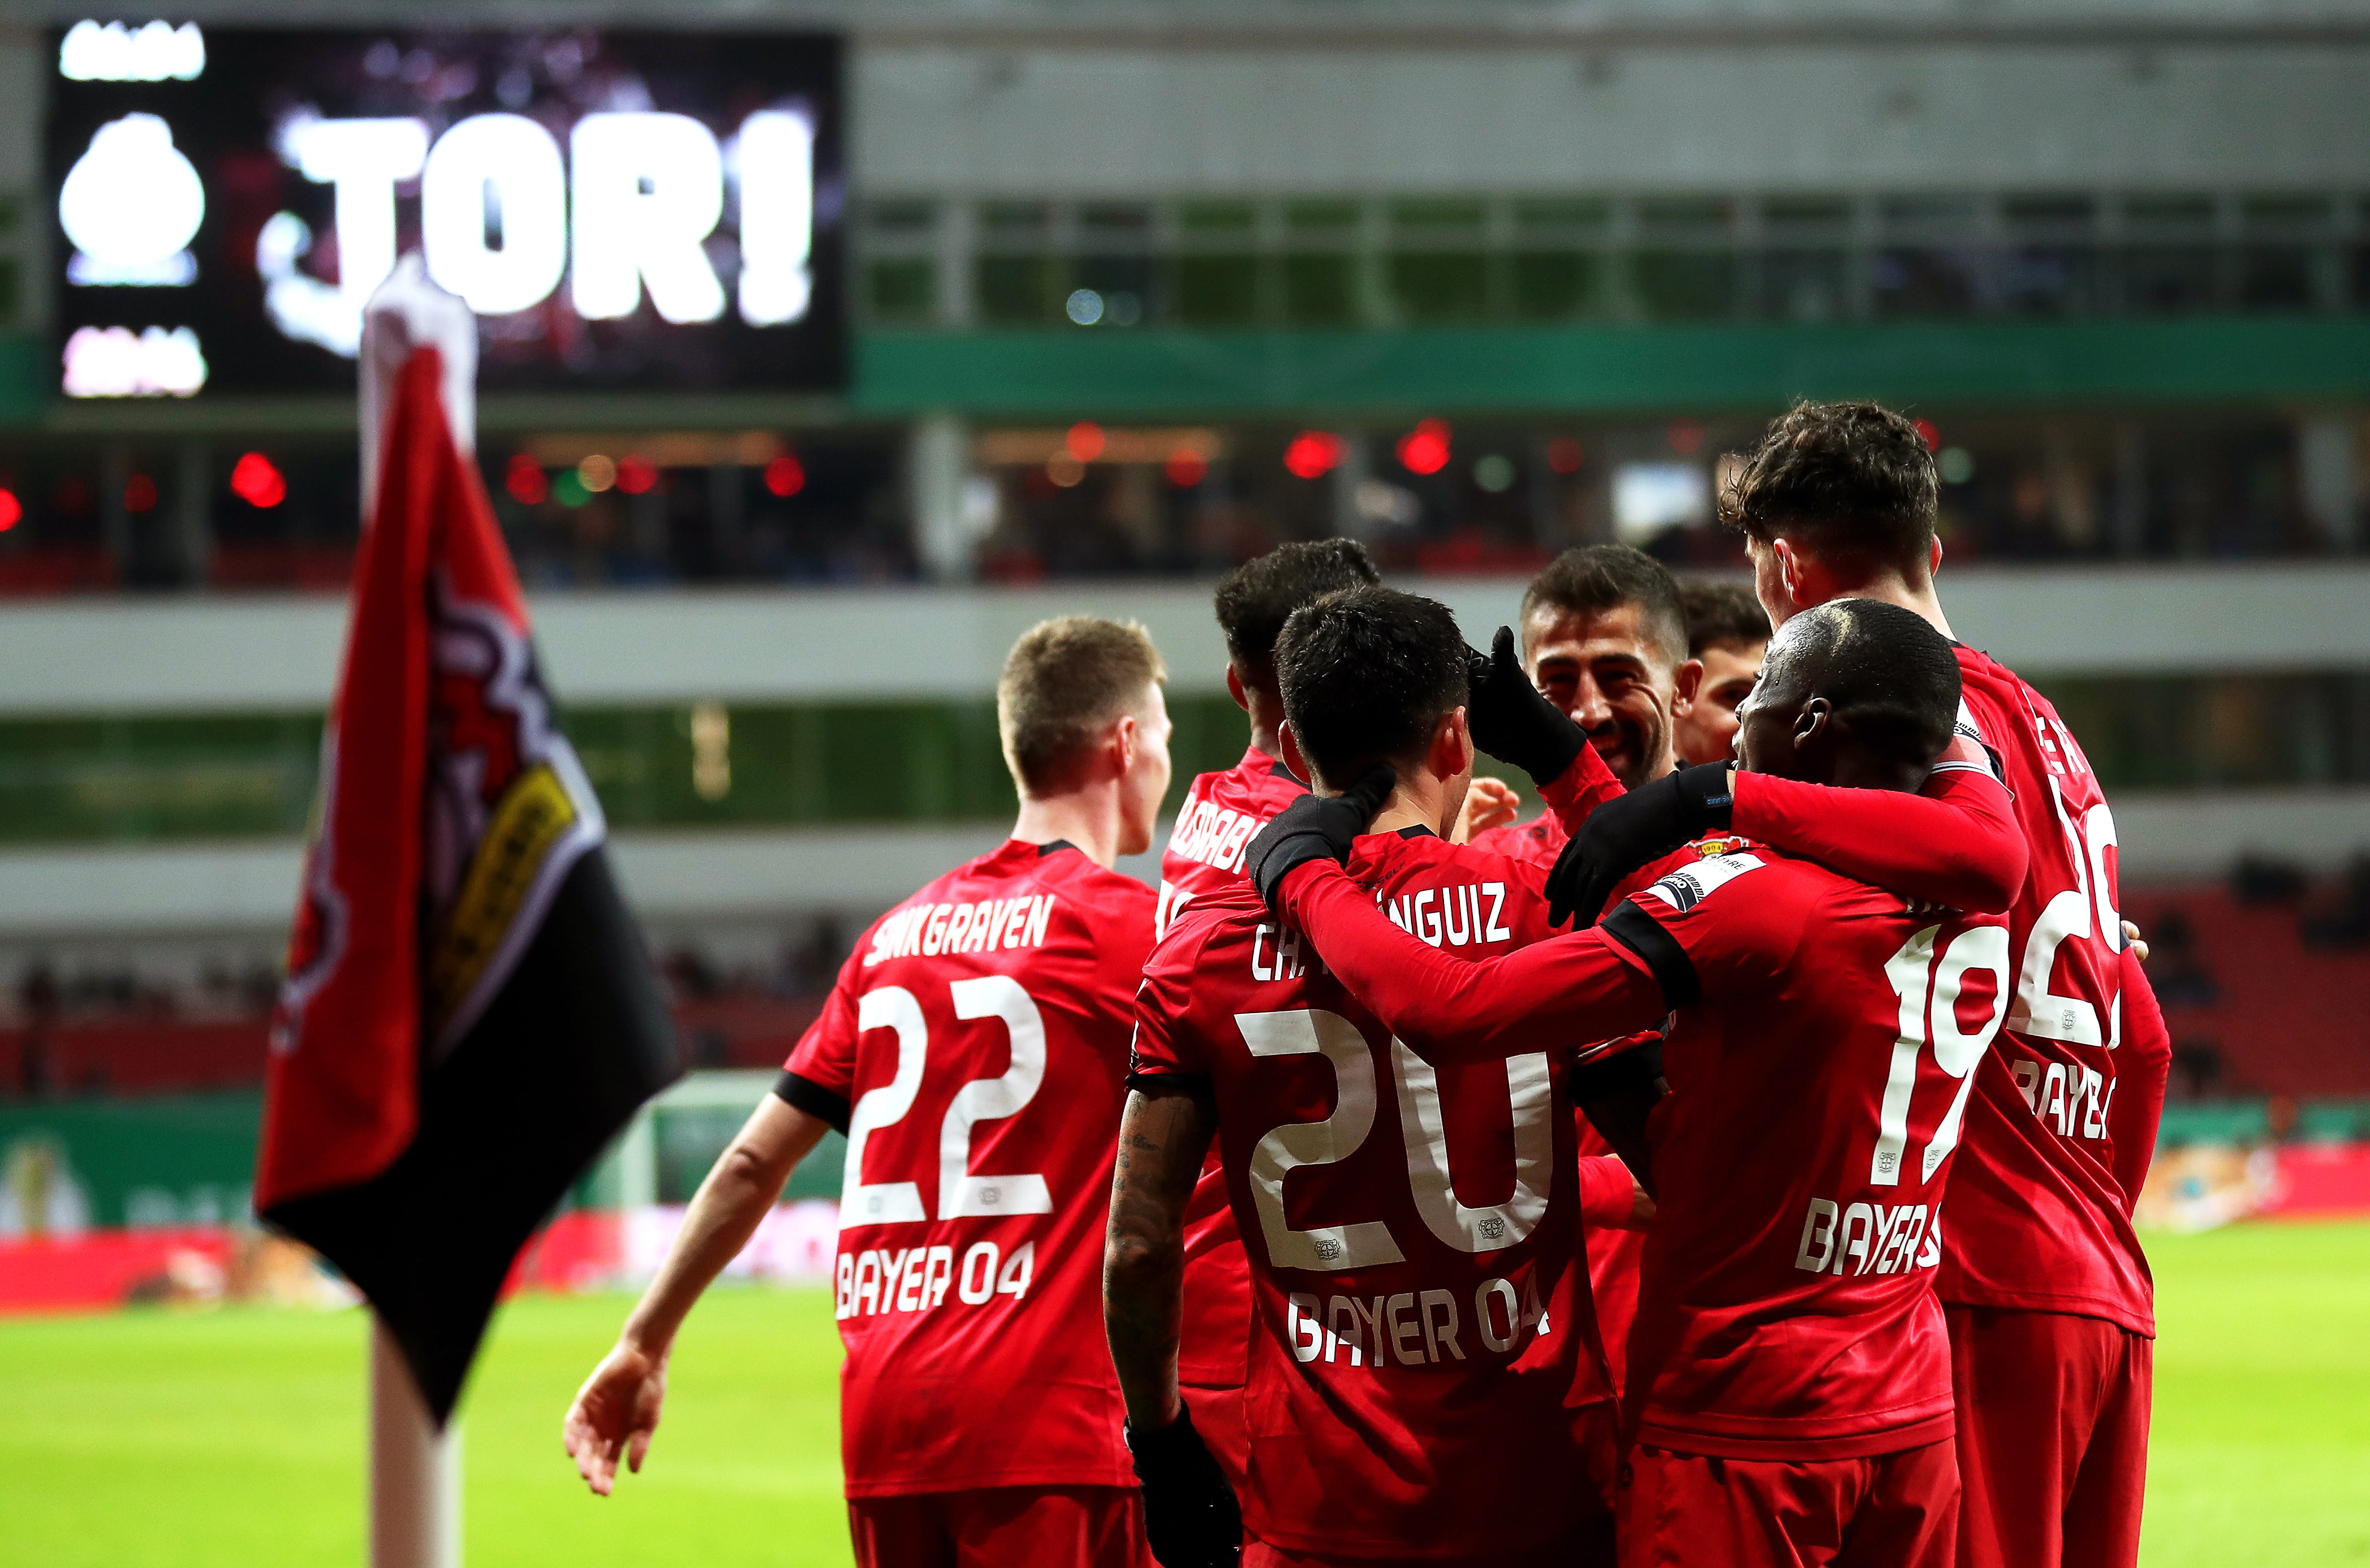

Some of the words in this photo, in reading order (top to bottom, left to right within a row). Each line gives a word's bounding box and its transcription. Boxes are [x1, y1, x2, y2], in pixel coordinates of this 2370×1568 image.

[863, 895, 1055, 967] SINKGRAVEN
[1252, 921, 1305, 981] CH.
[1870, 924, 2010, 1186] 19
[839, 975, 1053, 1230] 22
[1234, 1009, 1554, 1271] 20
[837, 1247, 952, 1320] BAYER
[959, 1242, 1035, 1305] 04
[1795, 1197, 1928, 1276] BAYER
[1287, 1289, 1466, 1367] BAYER
[1475, 1266, 1551, 1354] 04
